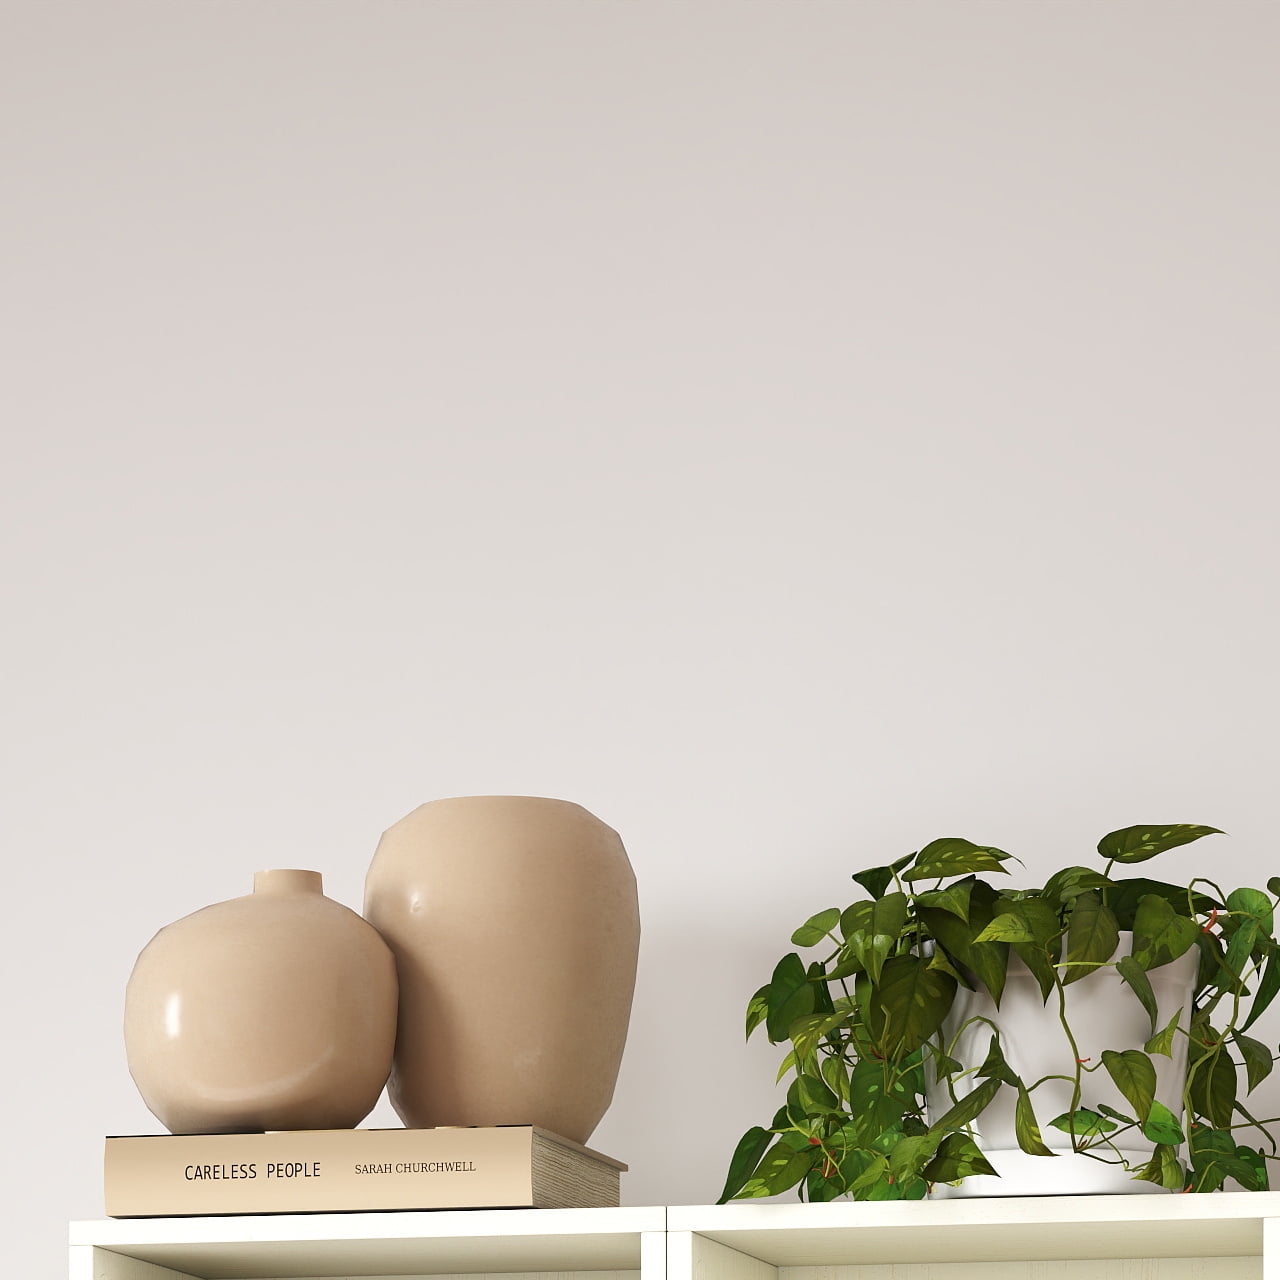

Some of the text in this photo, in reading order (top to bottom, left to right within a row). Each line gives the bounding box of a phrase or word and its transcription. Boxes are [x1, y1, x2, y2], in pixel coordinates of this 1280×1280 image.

[184, 1161, 321, 1181] CARELESS PEOPLE
[354, 1161, 477, 1175] SARAH CHURCHWELL
